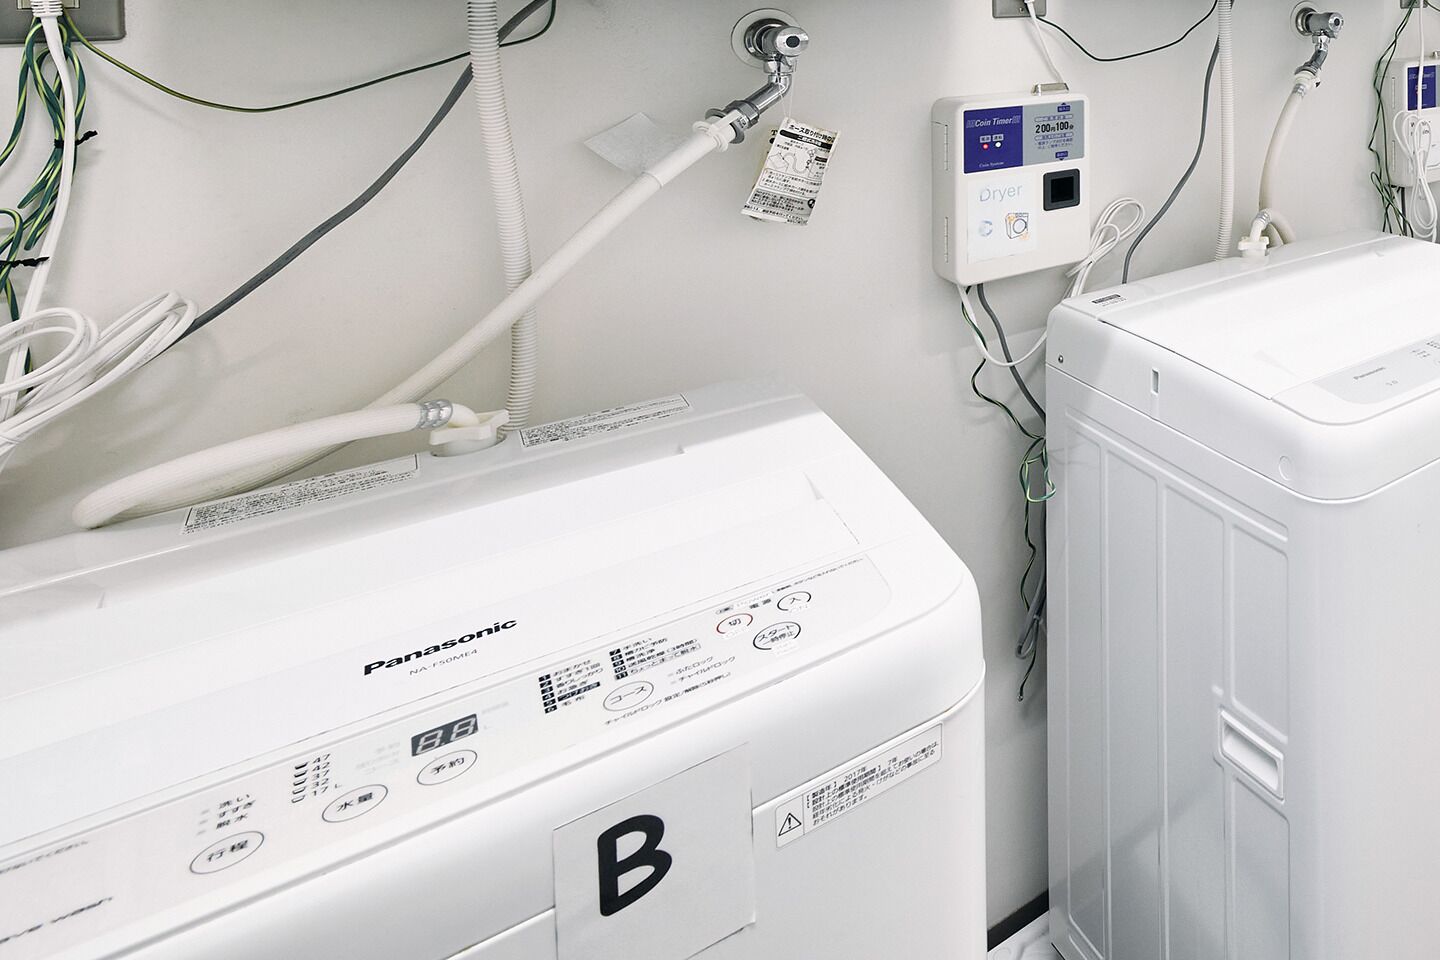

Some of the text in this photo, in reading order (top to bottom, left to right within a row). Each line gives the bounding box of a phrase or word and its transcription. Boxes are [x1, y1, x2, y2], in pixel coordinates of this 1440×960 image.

[974, 117, 1013, 128] Coin Timer
[979, 183, 1023, 203] Dryer
[758, 624, 795, 642] スタート
[364, 619, 518, 676] Panasonic
[610, 686, 647, 705] コース
[311, 761, 330, 772] 42
[312, 753, 331, 765] 47
[429, 757, 465, 776] 予約
[311, 778, 329, 787] 32
[312, 769, 330, 780] 37
[843, 766, 866, 782] 2017年
[218, 800, 256, 818] すすぎ
[336, 791, 373, 813] 水量
[206, 840, 249, 862] 行程
[597, 814, 673, 917] B
